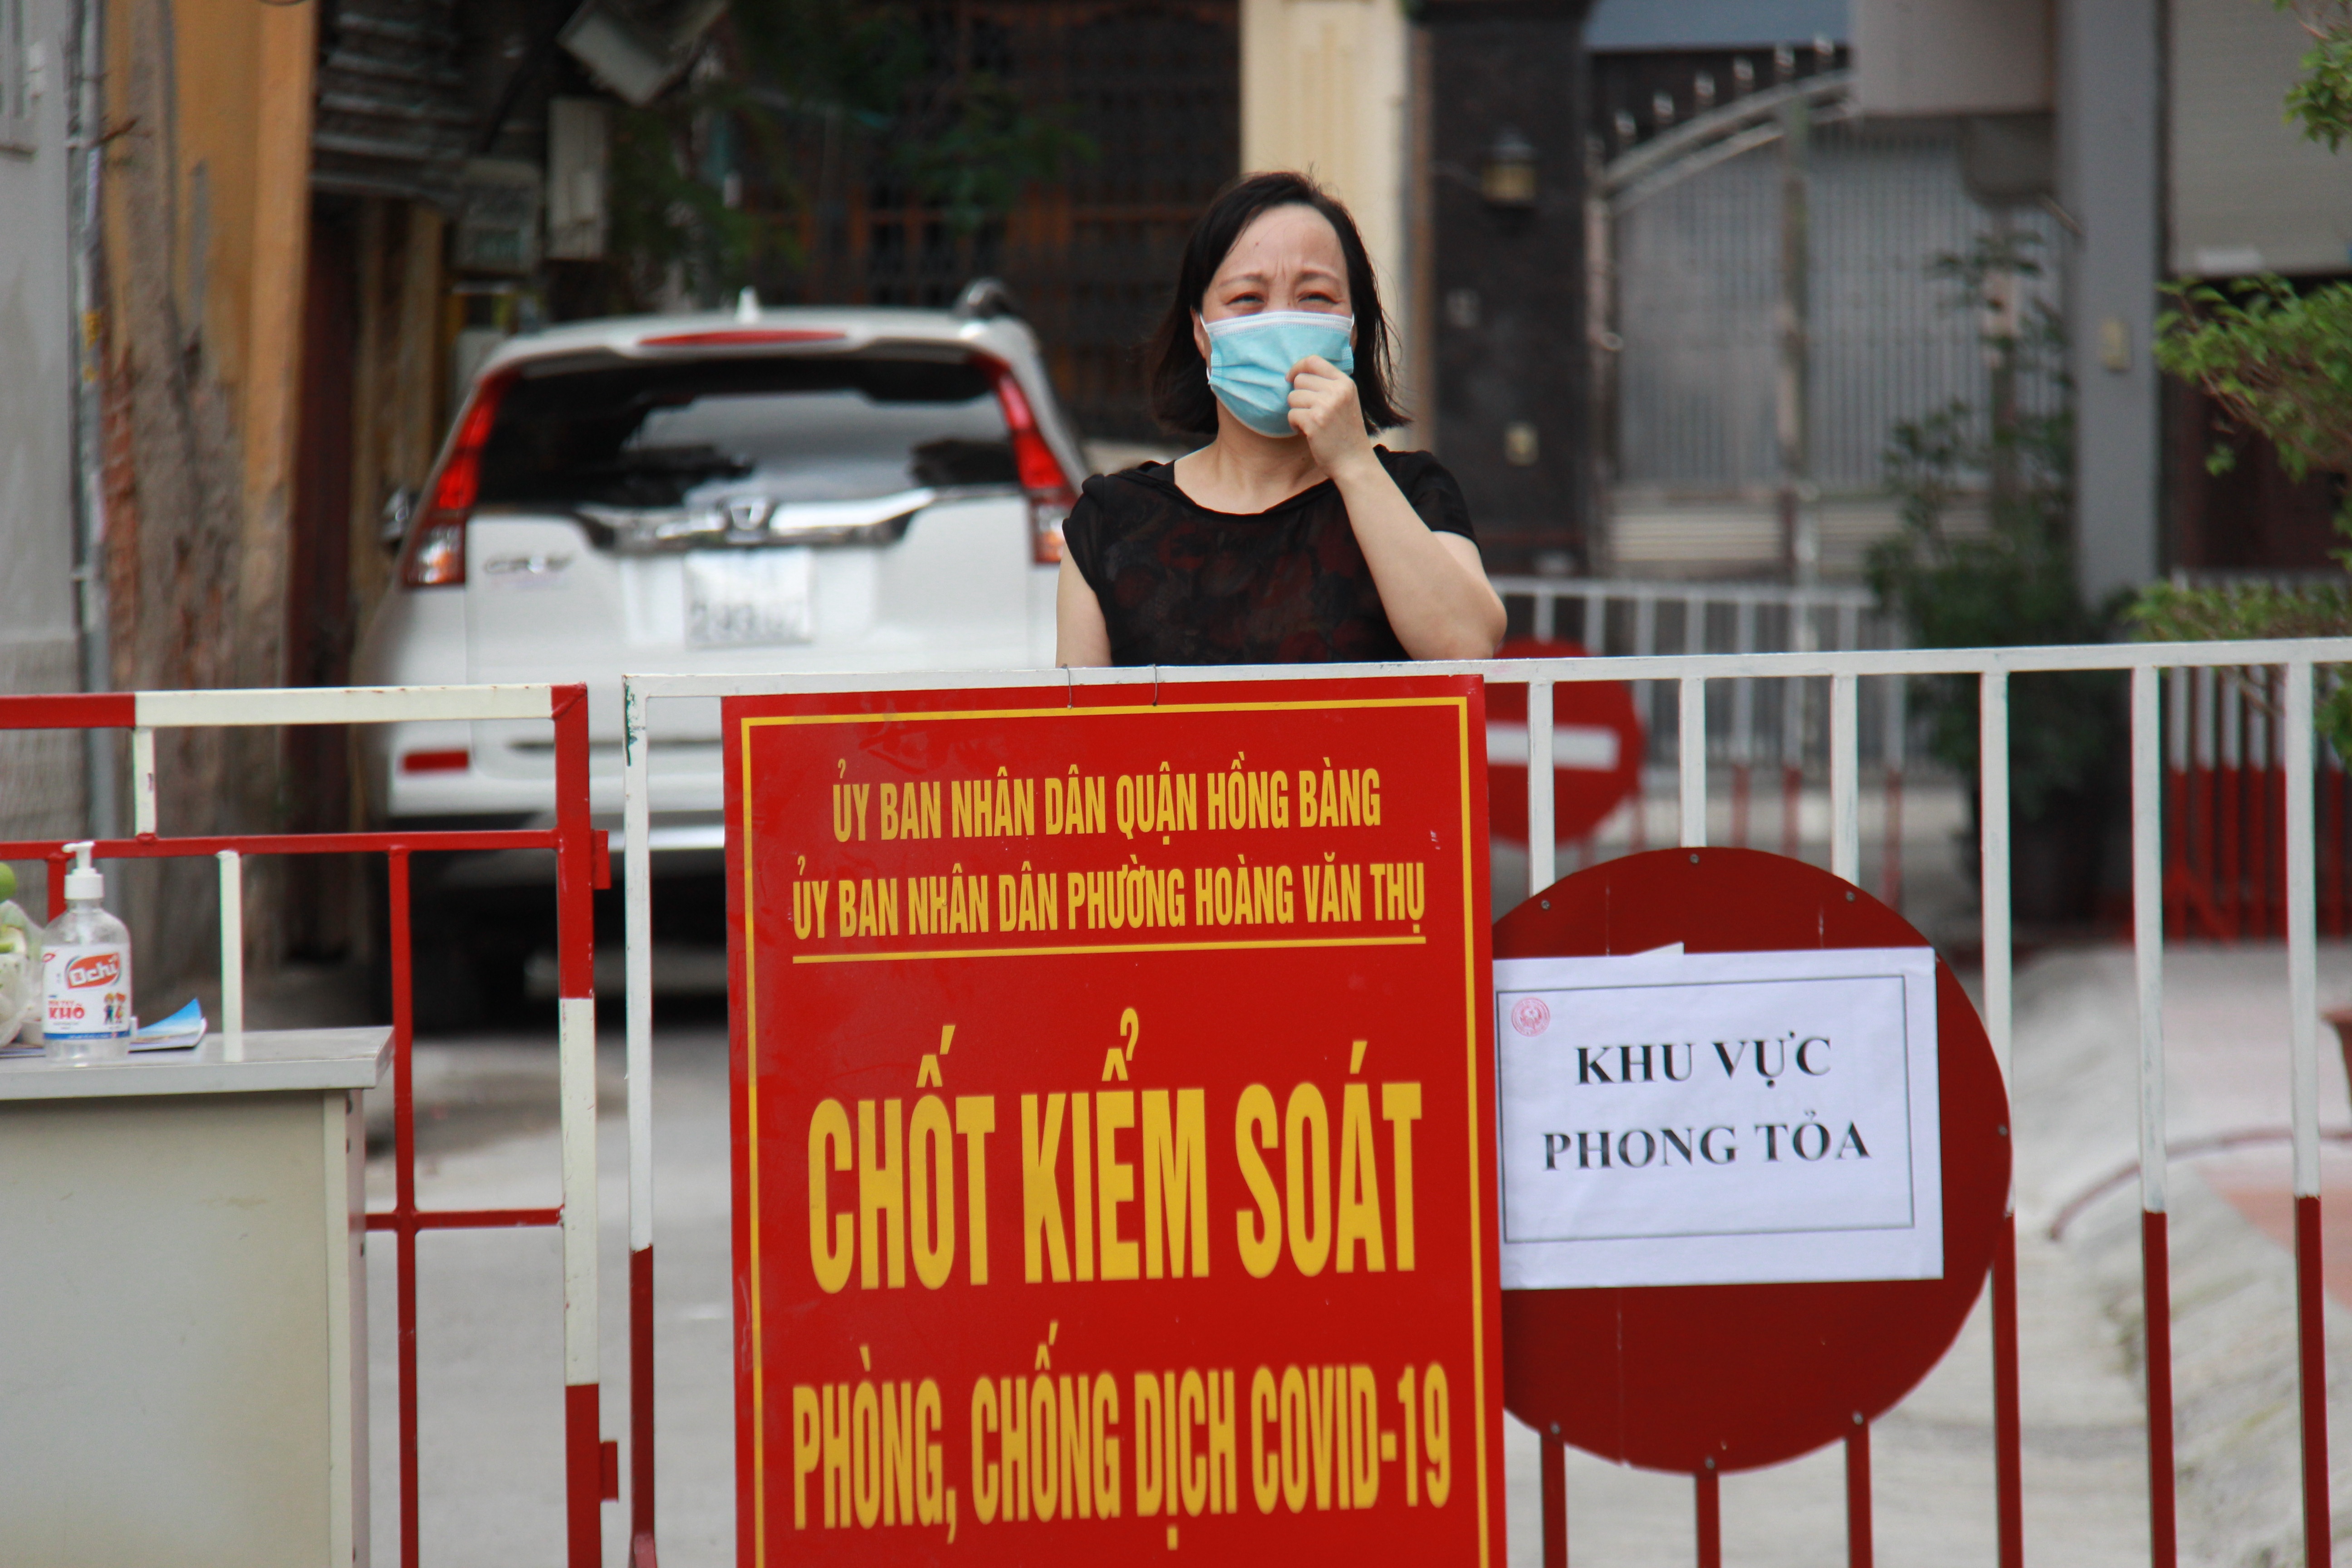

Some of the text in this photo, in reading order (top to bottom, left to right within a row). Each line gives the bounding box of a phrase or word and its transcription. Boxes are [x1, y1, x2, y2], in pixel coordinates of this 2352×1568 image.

[832, 751, 1381, 846] ỦY BAN NHÂN DÂN QUẬN HỒNG BÀNG
[792, 852, 1425, 940] ỦY BAN NHÂN DÂN PHƯỜNG HOÀNG VĂN THỤ
[69, 957, 118, 986] Ochi
[1575, 1031, 1832, 1088] KHU VỰC
[808, 1007, 1422, 1294] CHỐT KIỂM SOÁT
[1542, 1110, 1872, 1171] PHONG TỎA
[793, 1321, 1450, 1549] PHÒNG, CHỐNG DỊCH COVID-19
